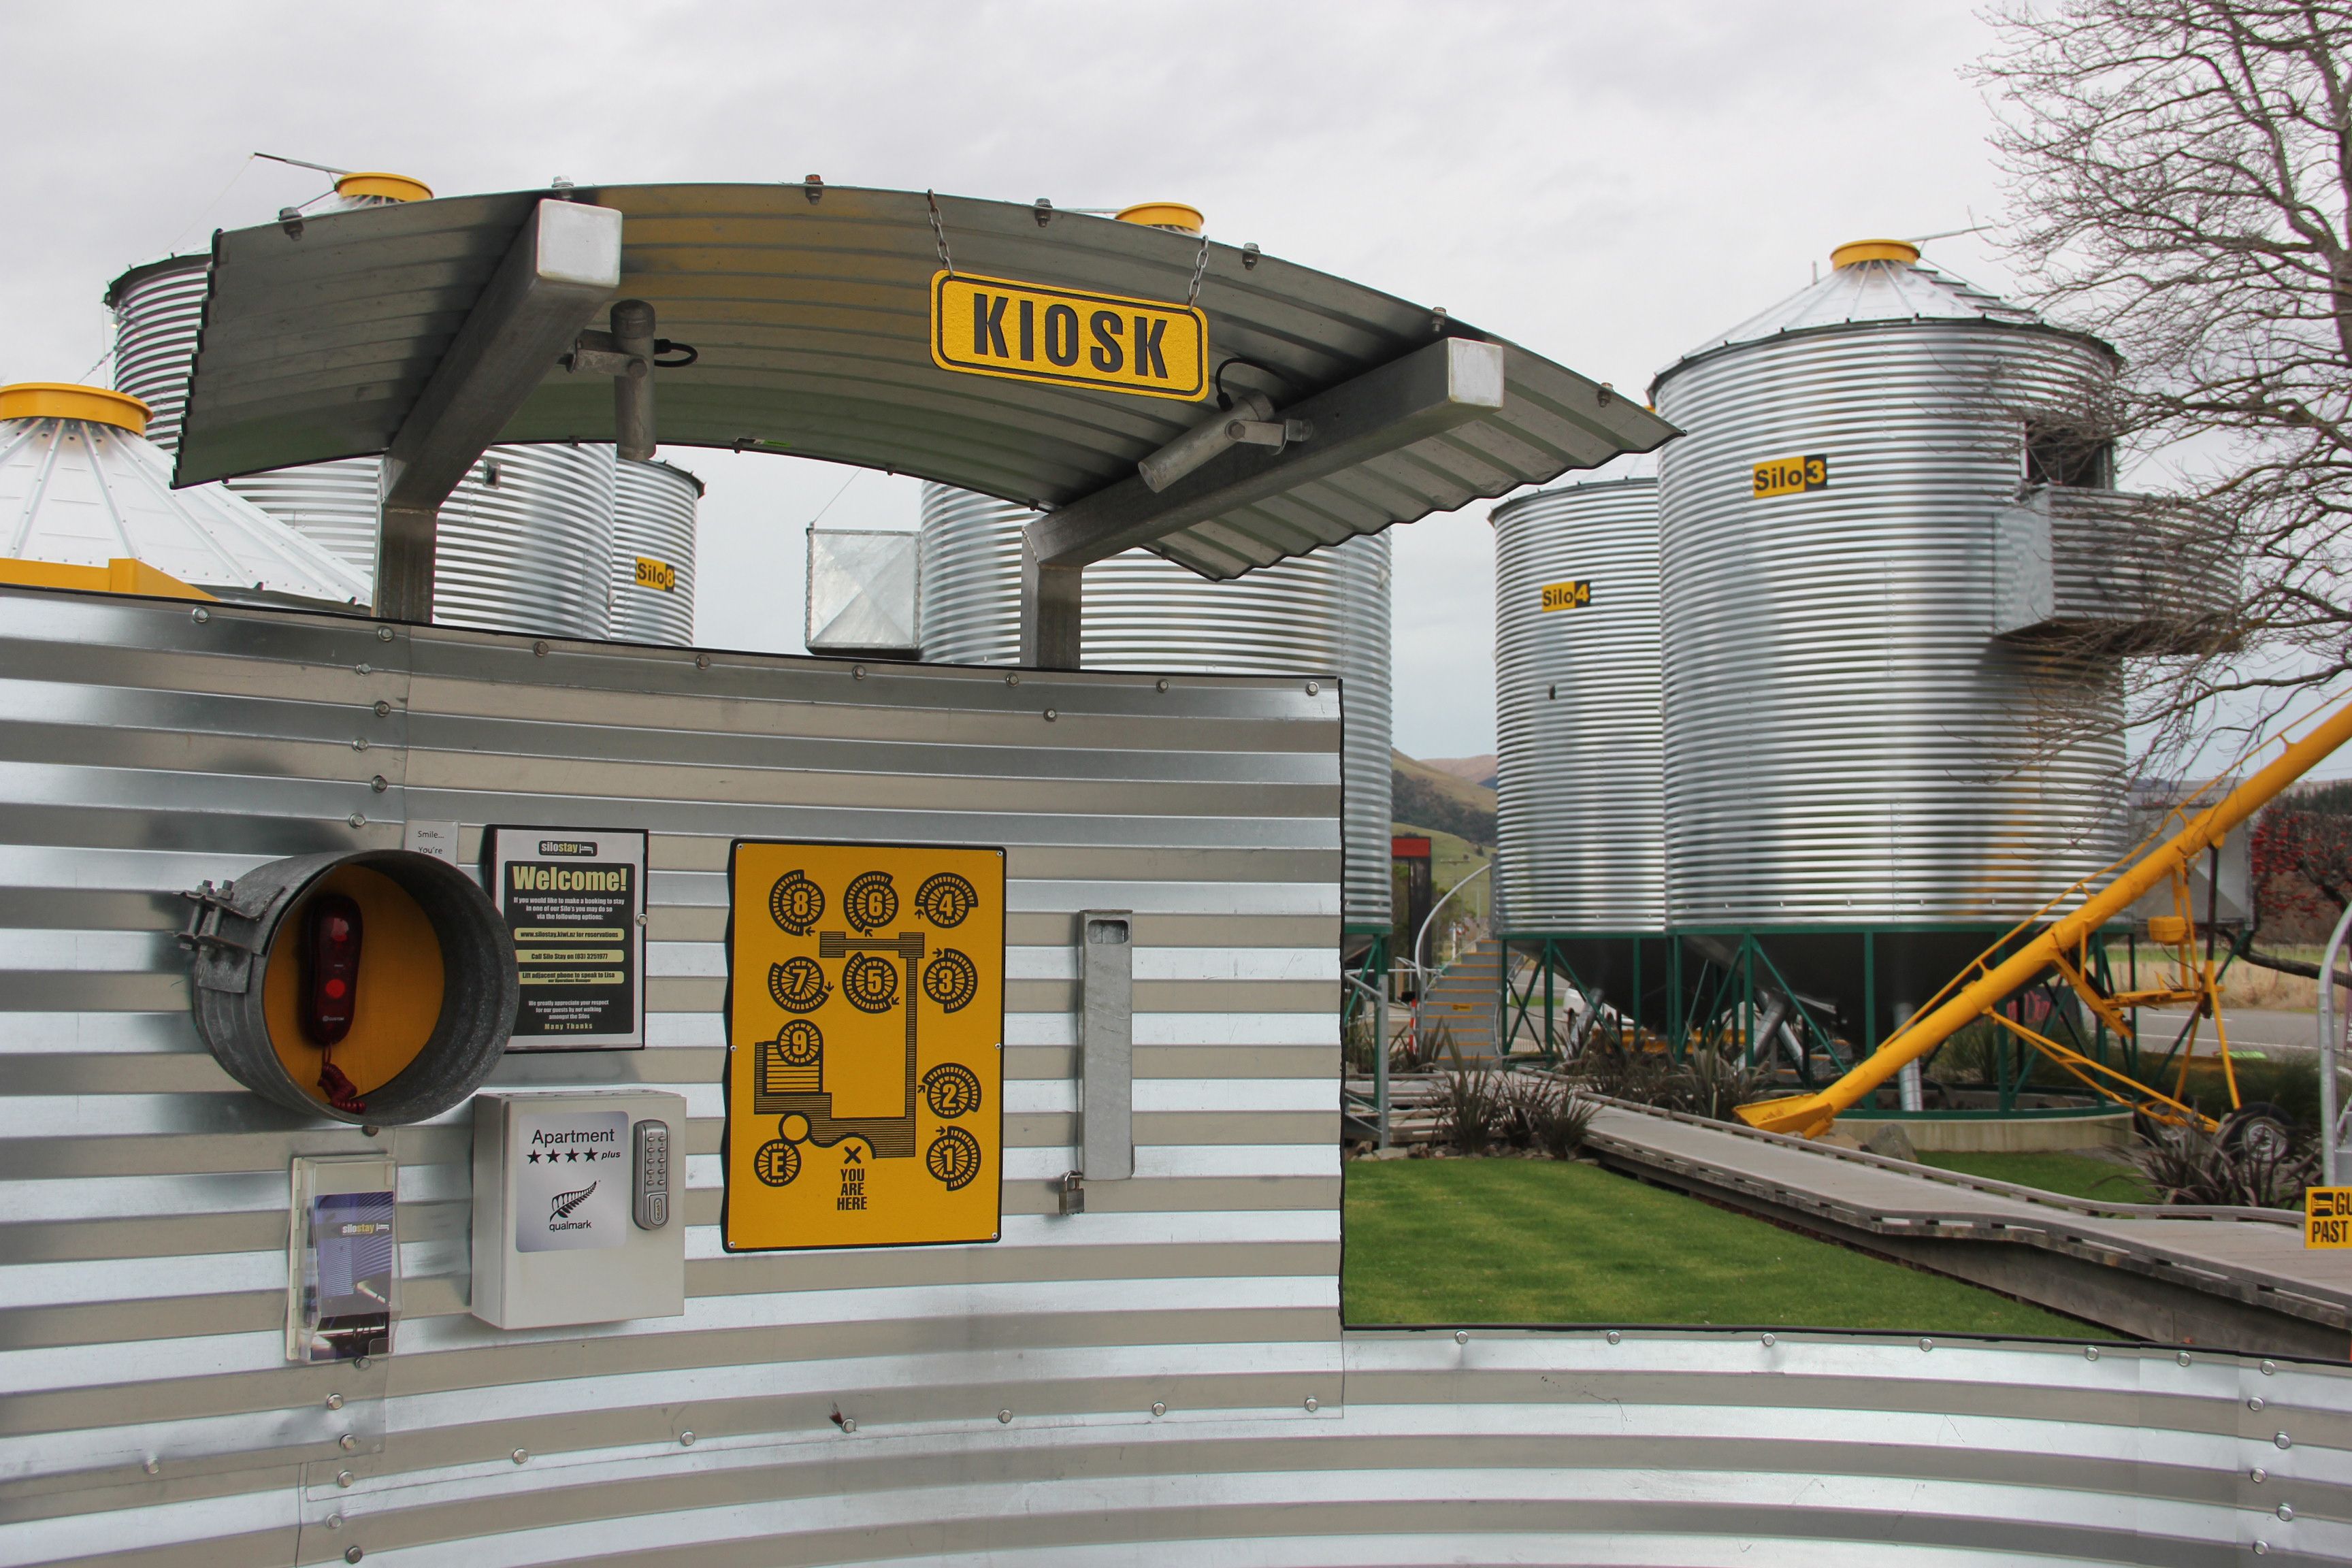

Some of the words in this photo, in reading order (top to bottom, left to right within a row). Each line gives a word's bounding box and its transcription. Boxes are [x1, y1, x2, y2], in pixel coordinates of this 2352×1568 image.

[974, 293, 1169, 379] KIOSK
[419, 846, 443, 854] You're
[541, 842, 578, 853] silostay
[512, 866, 627, 891] Welcome!
[792, 889, 809, 916] 8
[867, 891, 884, 917] 6
[938, 893, 955, 918] 4
[791, 968, 808, 994] 7
[866, 968, 883, 994] 5
[937, 968, 953, 994] 3
[791, 1029, 808, 1056] 9
[941, 1083, 958, 1109] 2
[532, 1129, 615, 1147] Apartment
[601, 1151, 621, 1160] plus
[770, 1151, 785, 1177] E
[942, 1146, 954, 1172] 1
[840, 1169, 865, 1181] YOU
[840, 1183, 864, 1196] ARE
[836, 1197, 867, 1210] HERE
[342, 1224, 374, 1234] silostay
[549, 1220, 592, 1232] qualmark
[2311, 1220, 2348, 1243] PAST
